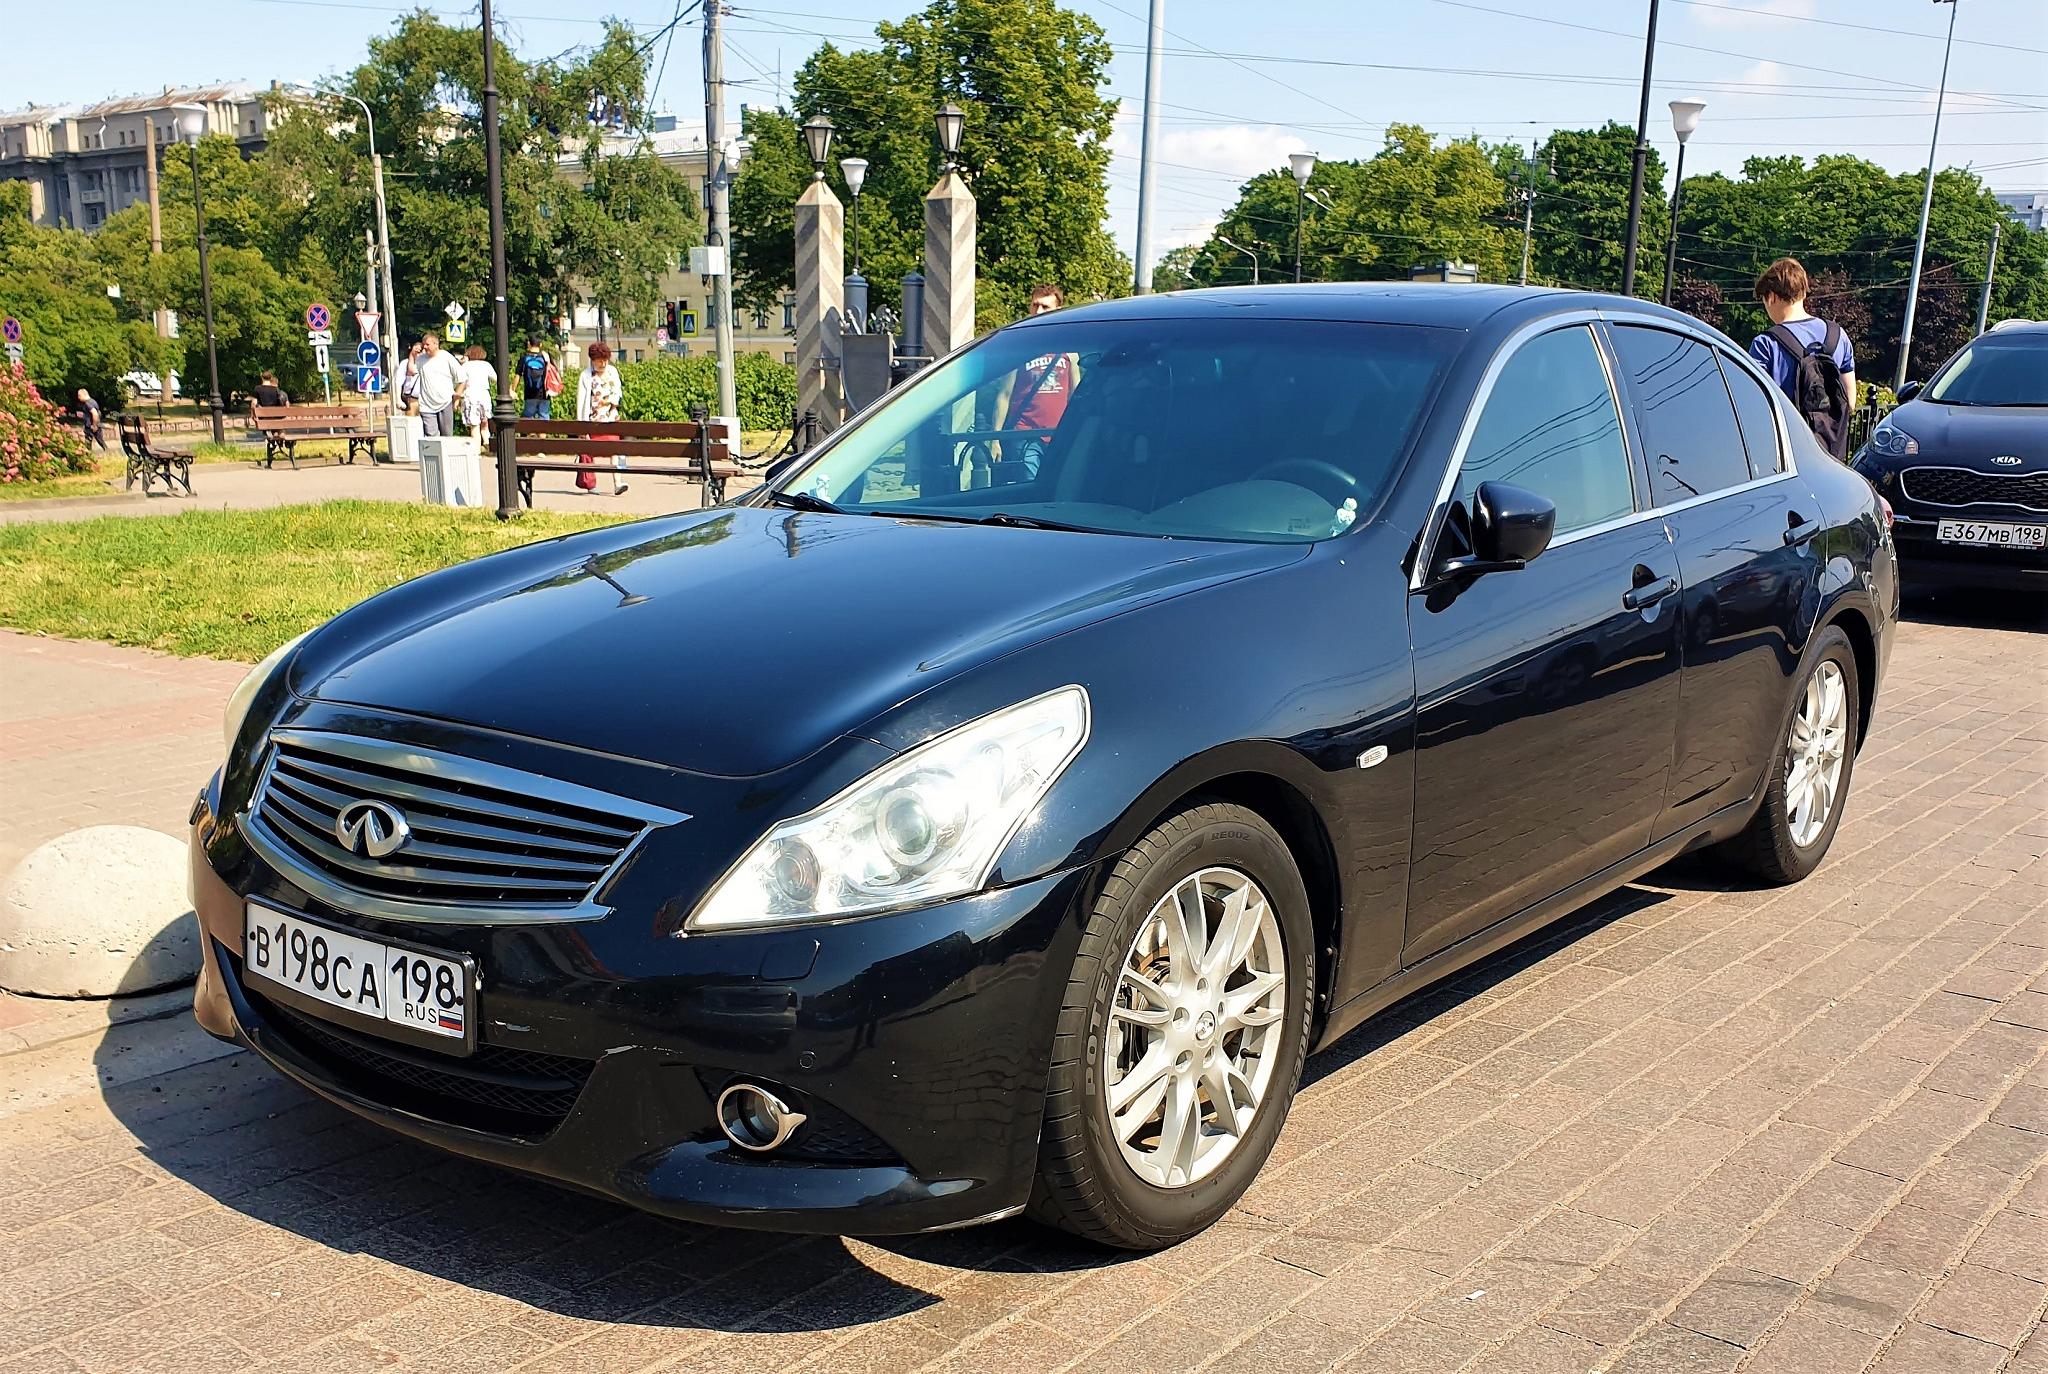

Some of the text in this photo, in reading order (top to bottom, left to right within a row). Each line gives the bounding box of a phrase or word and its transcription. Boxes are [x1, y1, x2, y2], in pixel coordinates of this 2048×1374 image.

[1995, 456, 2017, 465] KIA
[1942, 524, 2041, 543] Е367МВ 198
[1211, 830, 1251, 841] RE002
[256, 922, 456, 1009] В198СА 198
[1084, 887, 1149, 1096] POTENZA
[404, 1002, 437, 1024] RUS
